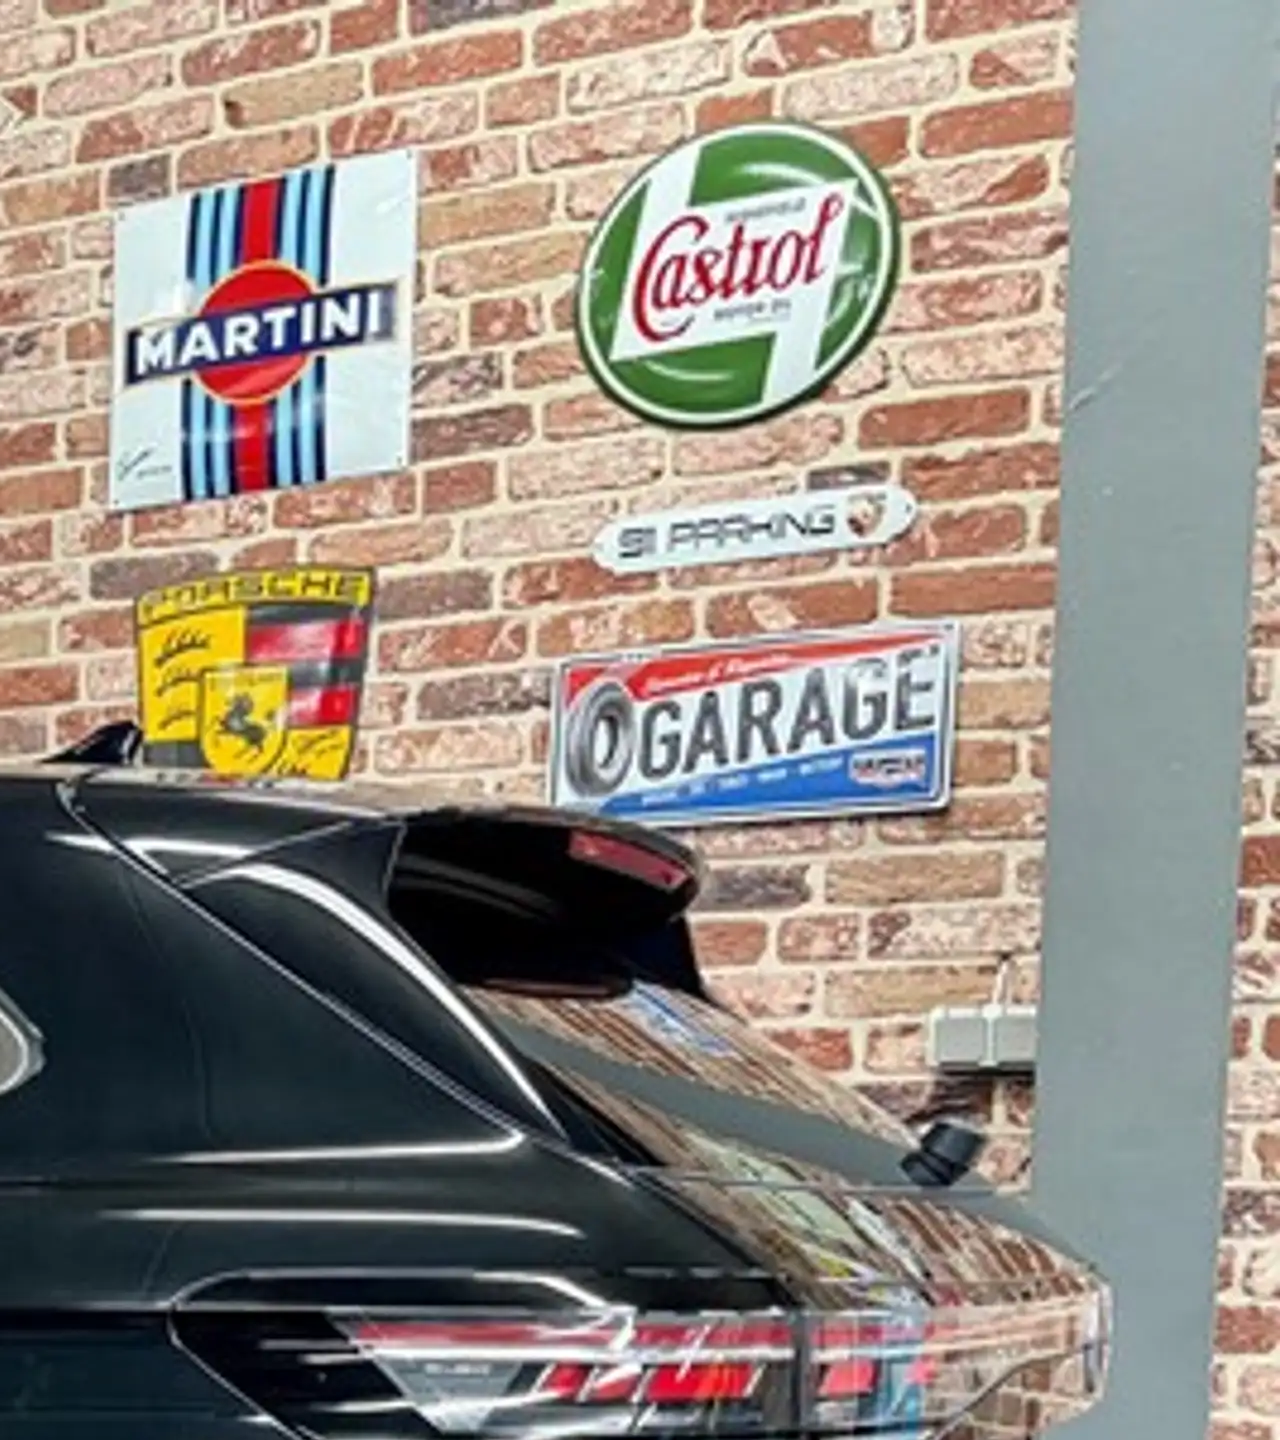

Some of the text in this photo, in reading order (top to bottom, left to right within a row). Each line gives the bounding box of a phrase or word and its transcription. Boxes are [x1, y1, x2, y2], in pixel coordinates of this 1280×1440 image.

[632, 191, 844, 342] Castrol
[137, 291, 381, 377] MARTINI
[667, 504, 836, 552] PARKING
[137, 571, 368, 626] PORSCHE
[640, 645, 938, 782] GARAGE
